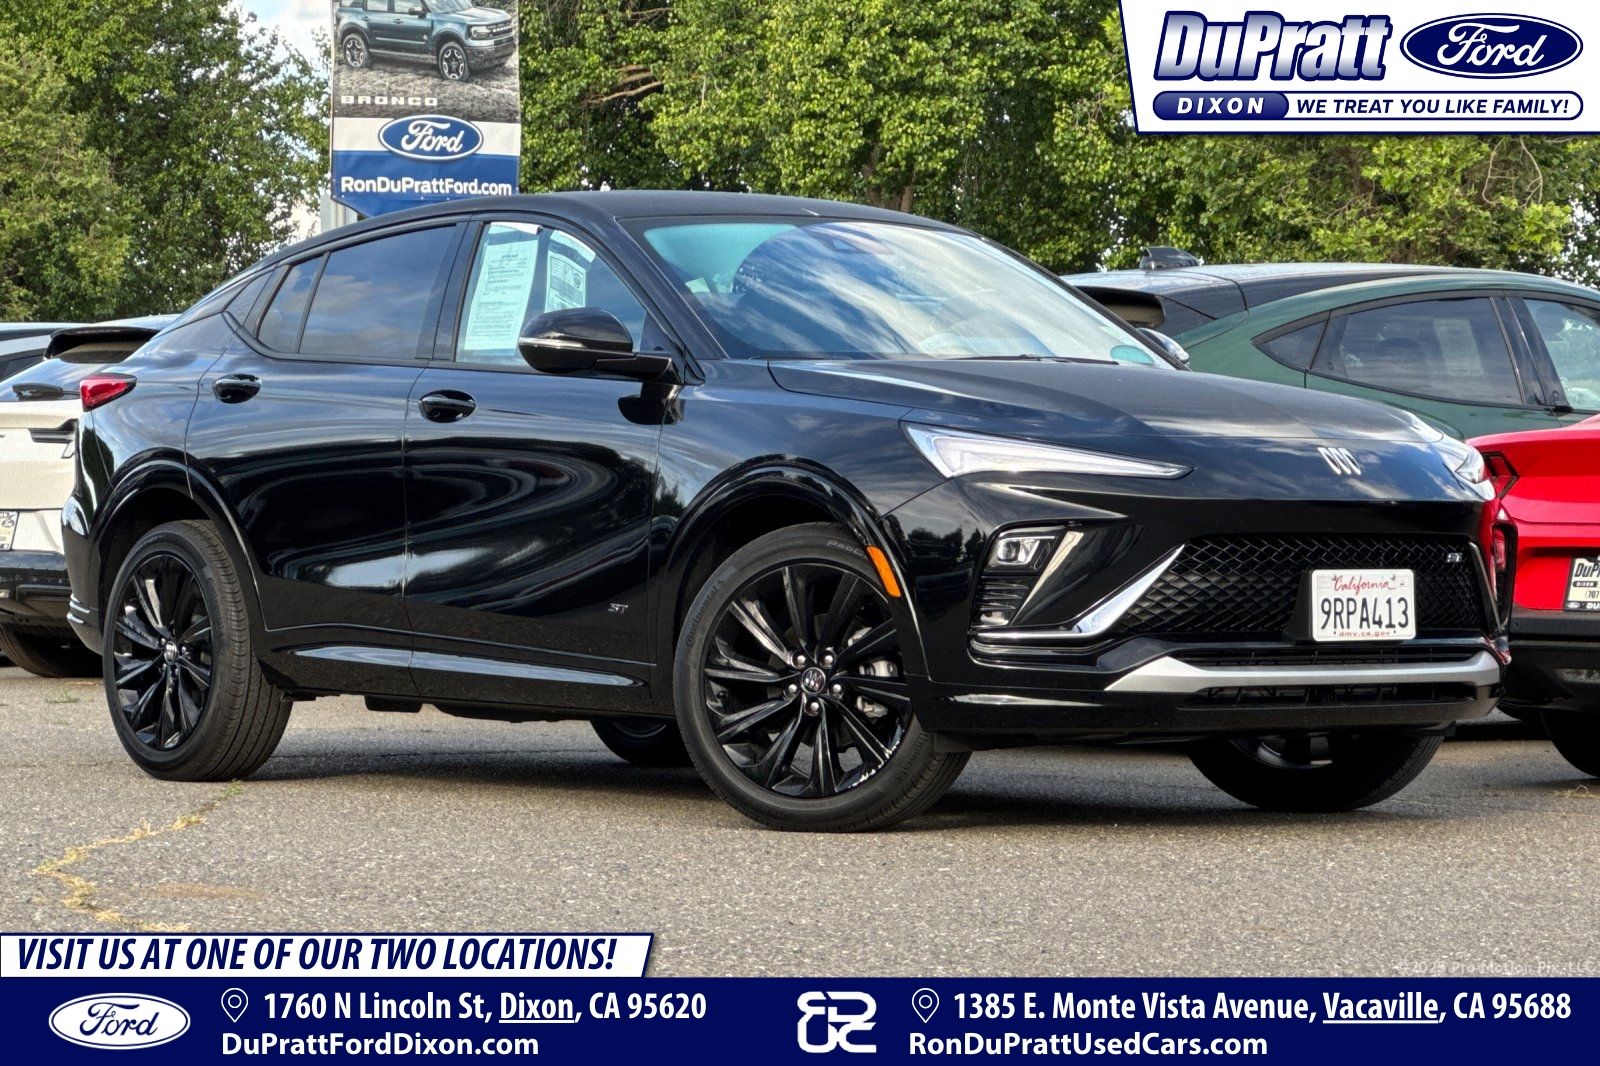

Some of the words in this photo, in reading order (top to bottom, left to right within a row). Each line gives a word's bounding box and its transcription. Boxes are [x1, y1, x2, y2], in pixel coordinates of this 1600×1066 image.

[341, 95, 438, 106] BRONCO
[401, 120, 464, 152] Ford
[341, 176, 512, 196] RonDuPrattFord.com
[1333, 575, 1396, 595] California
[1321, 597, 1409, 629] 9RPA413
